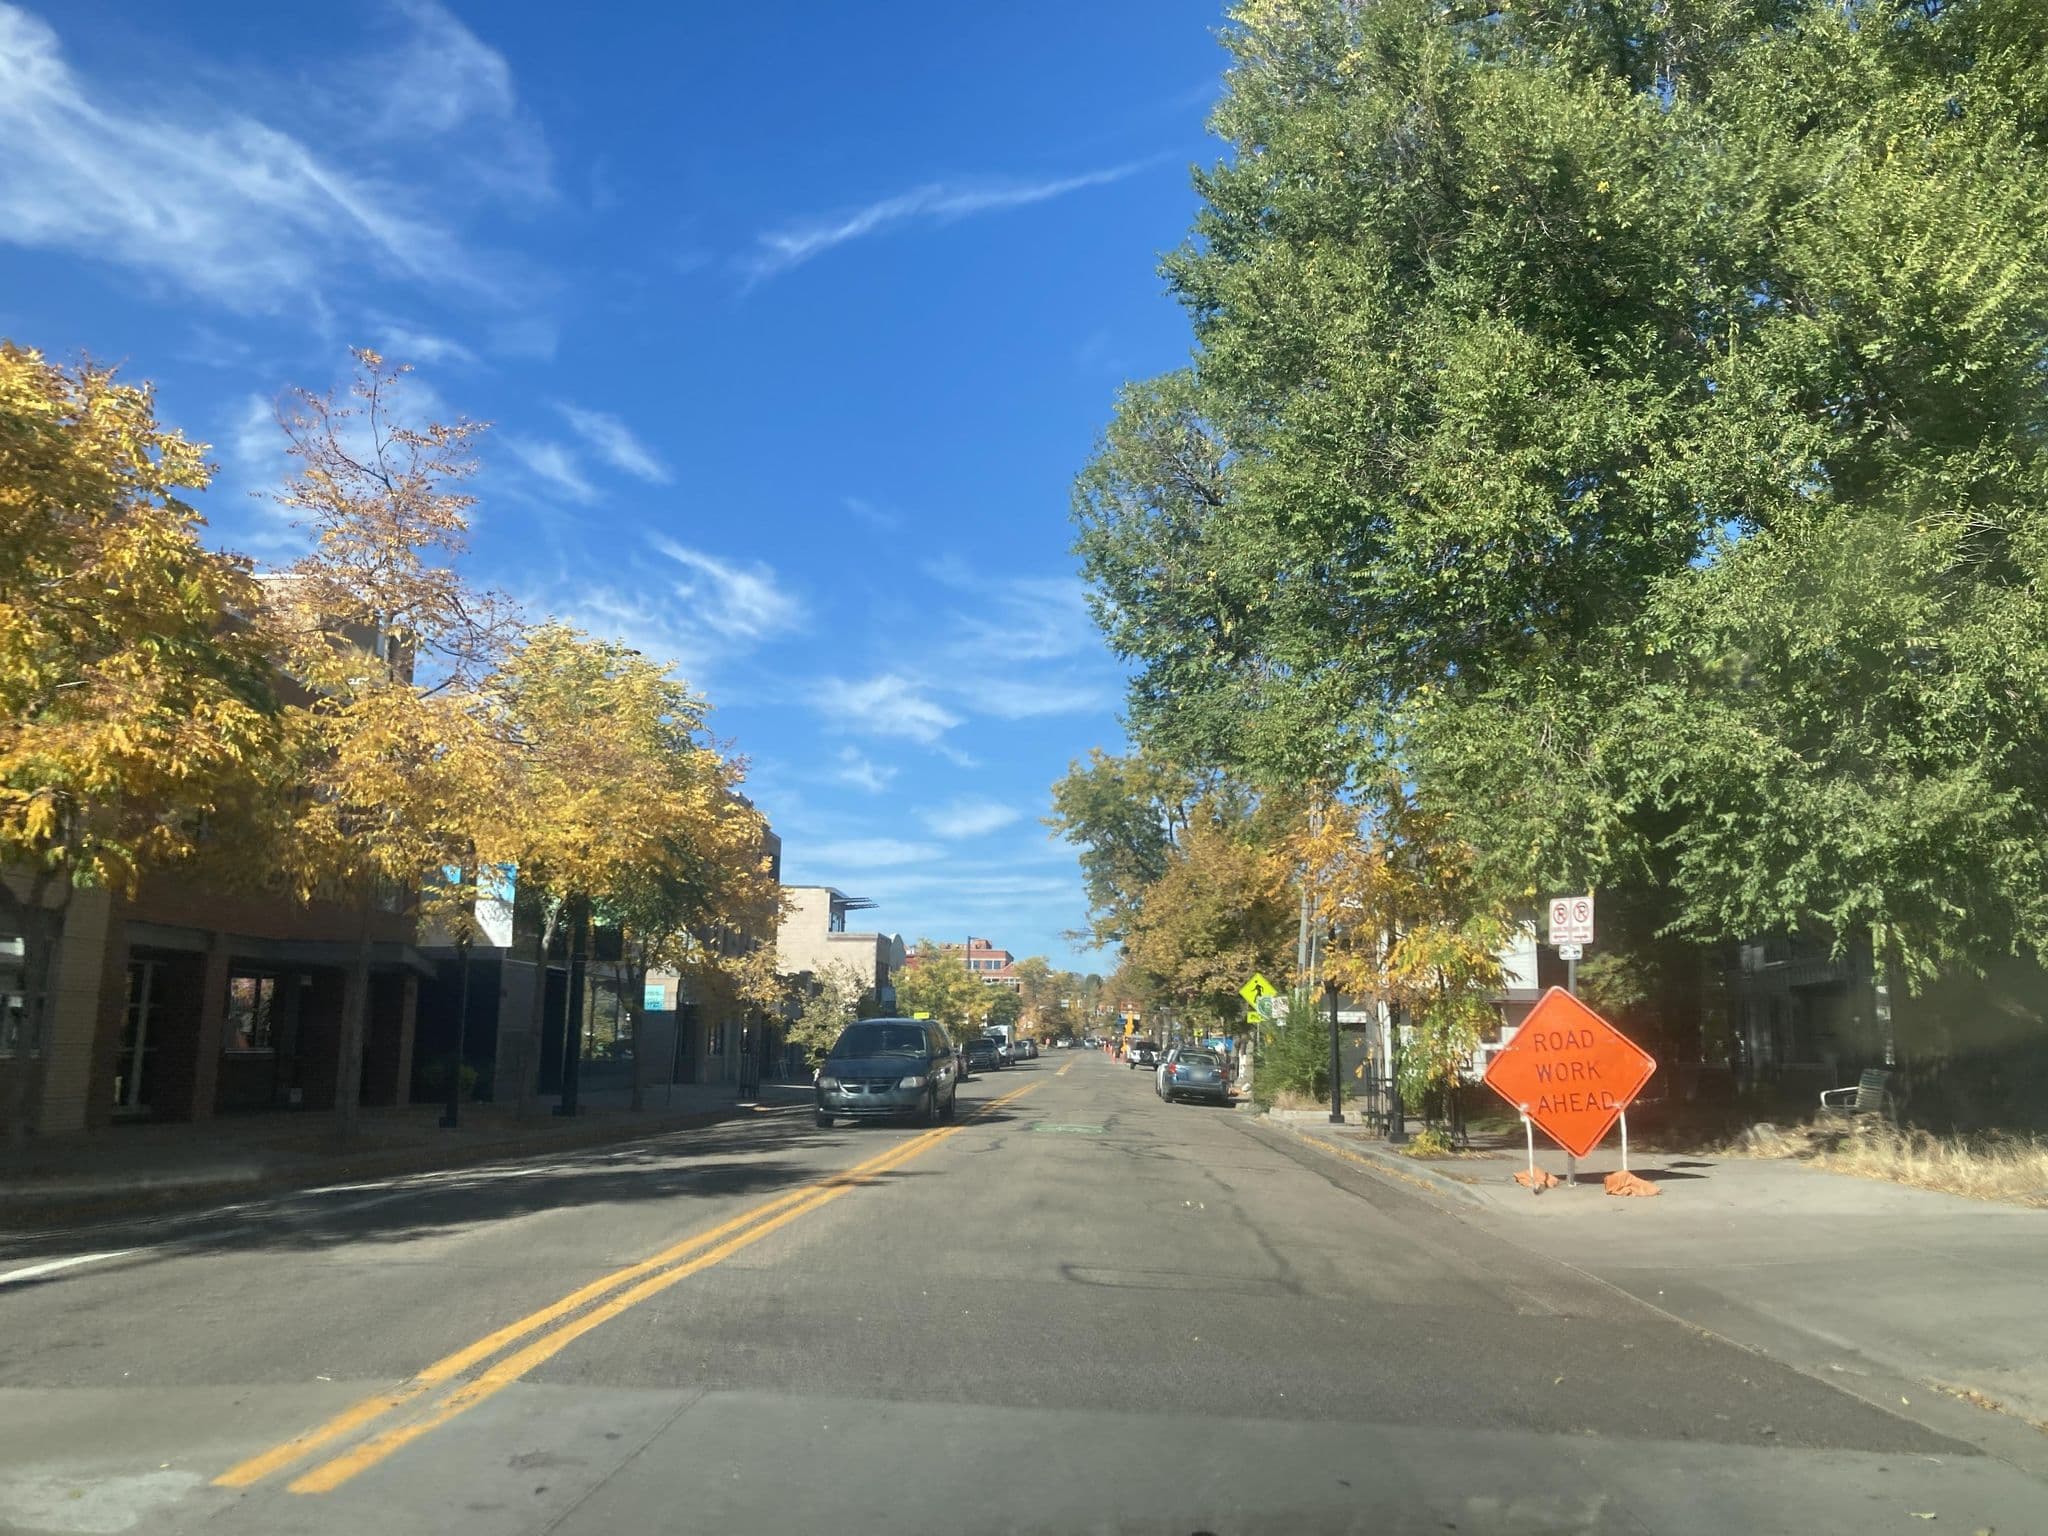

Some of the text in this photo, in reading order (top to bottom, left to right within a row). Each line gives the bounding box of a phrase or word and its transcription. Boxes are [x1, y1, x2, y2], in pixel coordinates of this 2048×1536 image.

[1534, 1029, 1594, 1053] ROAD
[1535, 1060, 1602, 1083] WORK
[1537, 1091, 1615, 1115] AHEAD
